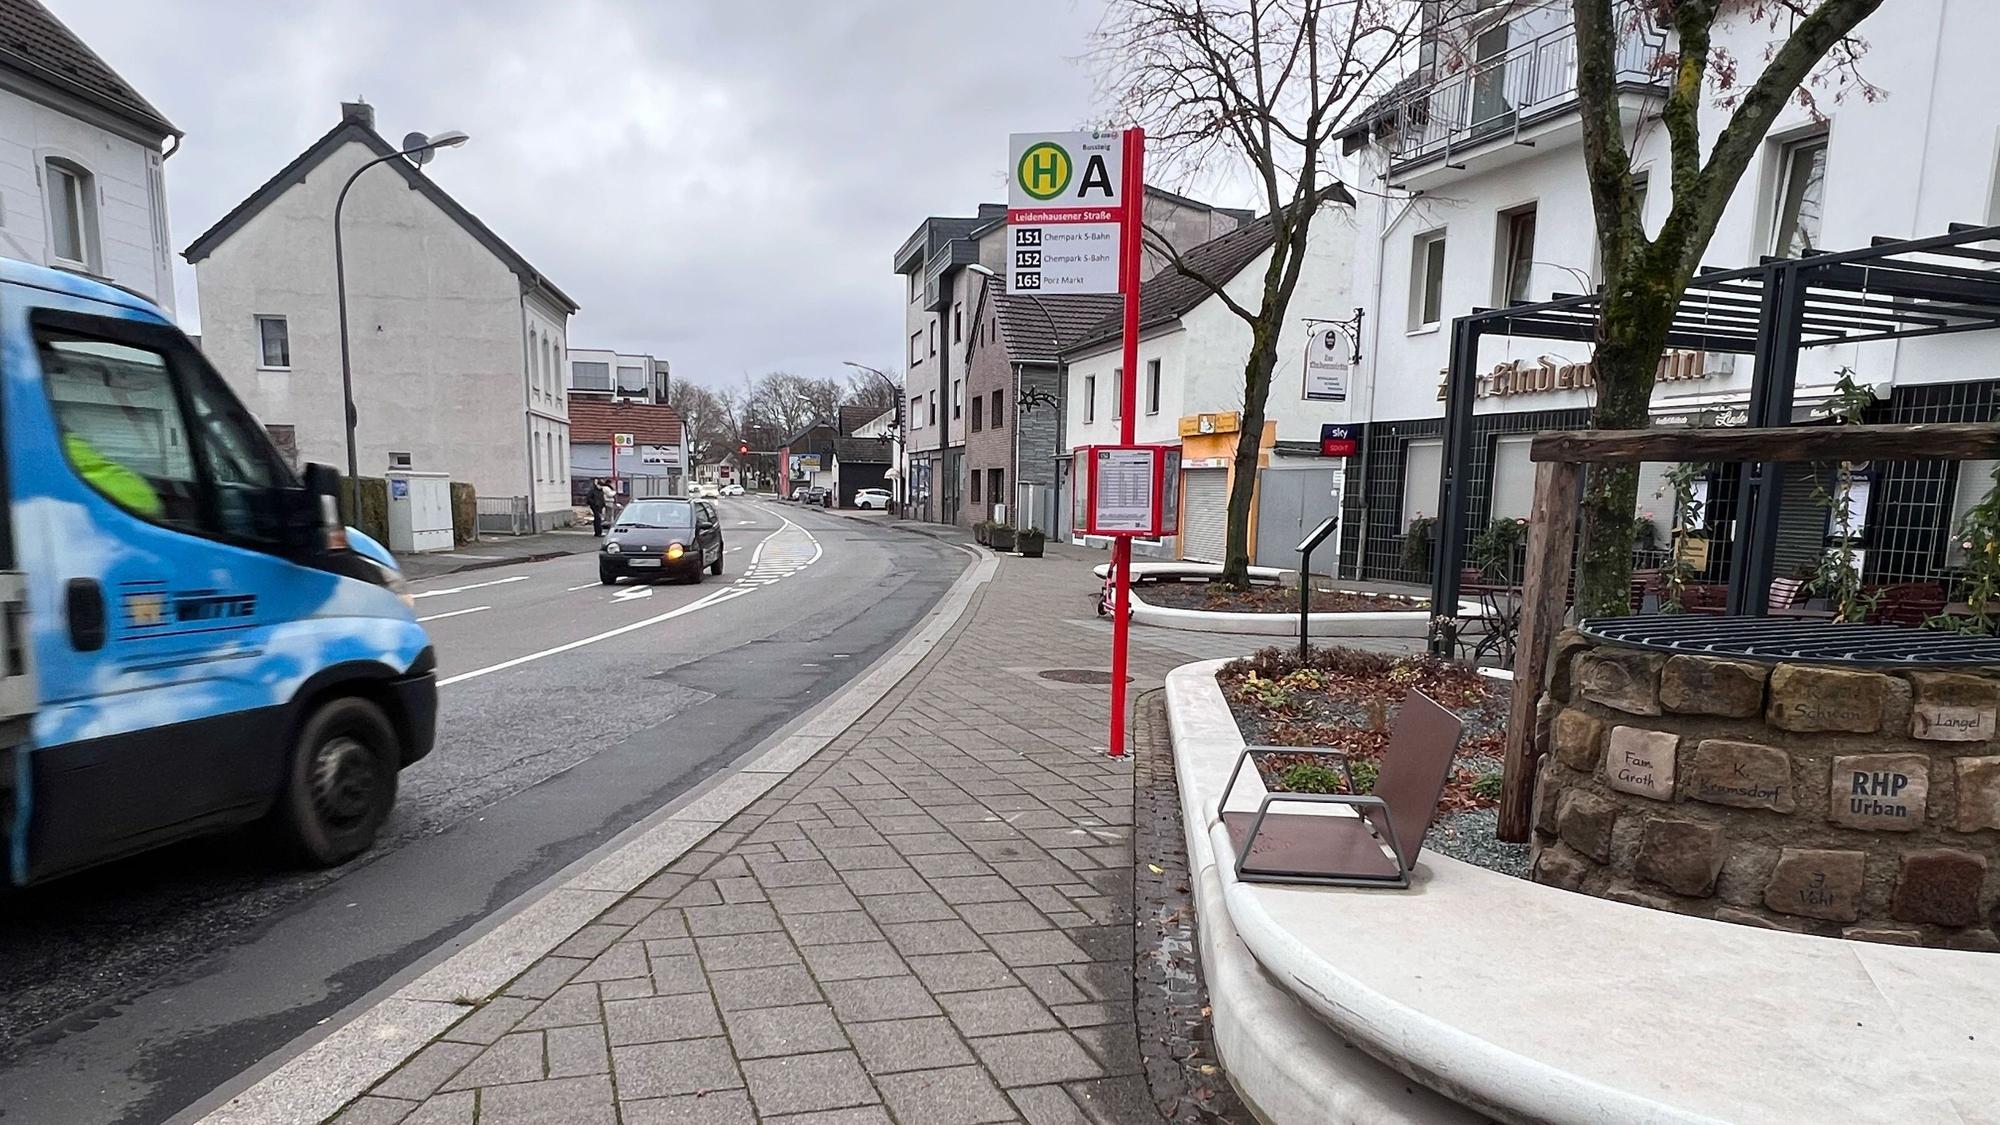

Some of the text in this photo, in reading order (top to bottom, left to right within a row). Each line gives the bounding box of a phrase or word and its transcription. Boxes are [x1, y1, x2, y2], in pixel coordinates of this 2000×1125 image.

[1082, 143, 1111, 151] Bussteig
[1032, 153, 1058, 189] H
[1077, 154, 1114, 198] A
[1015, 210, 1112, 222] Leidenhausener Straße
[1017, 231, 1111, 244] 151 Chempark S-Bahn
[1017, 253, 1040, 266] 152
[1043, 254, 1082, 264] Chempark
[1016, 274, 1084, 287] 165 Porz Markt
[1332, 427, 1348, 440] sky
[1936, 712, 1980, 732] Langel
[1618, 768, 1655, 789] Groth
[1852, 771, 1908, 797] RHP
[1850, 799, 1907, 818] Urban
